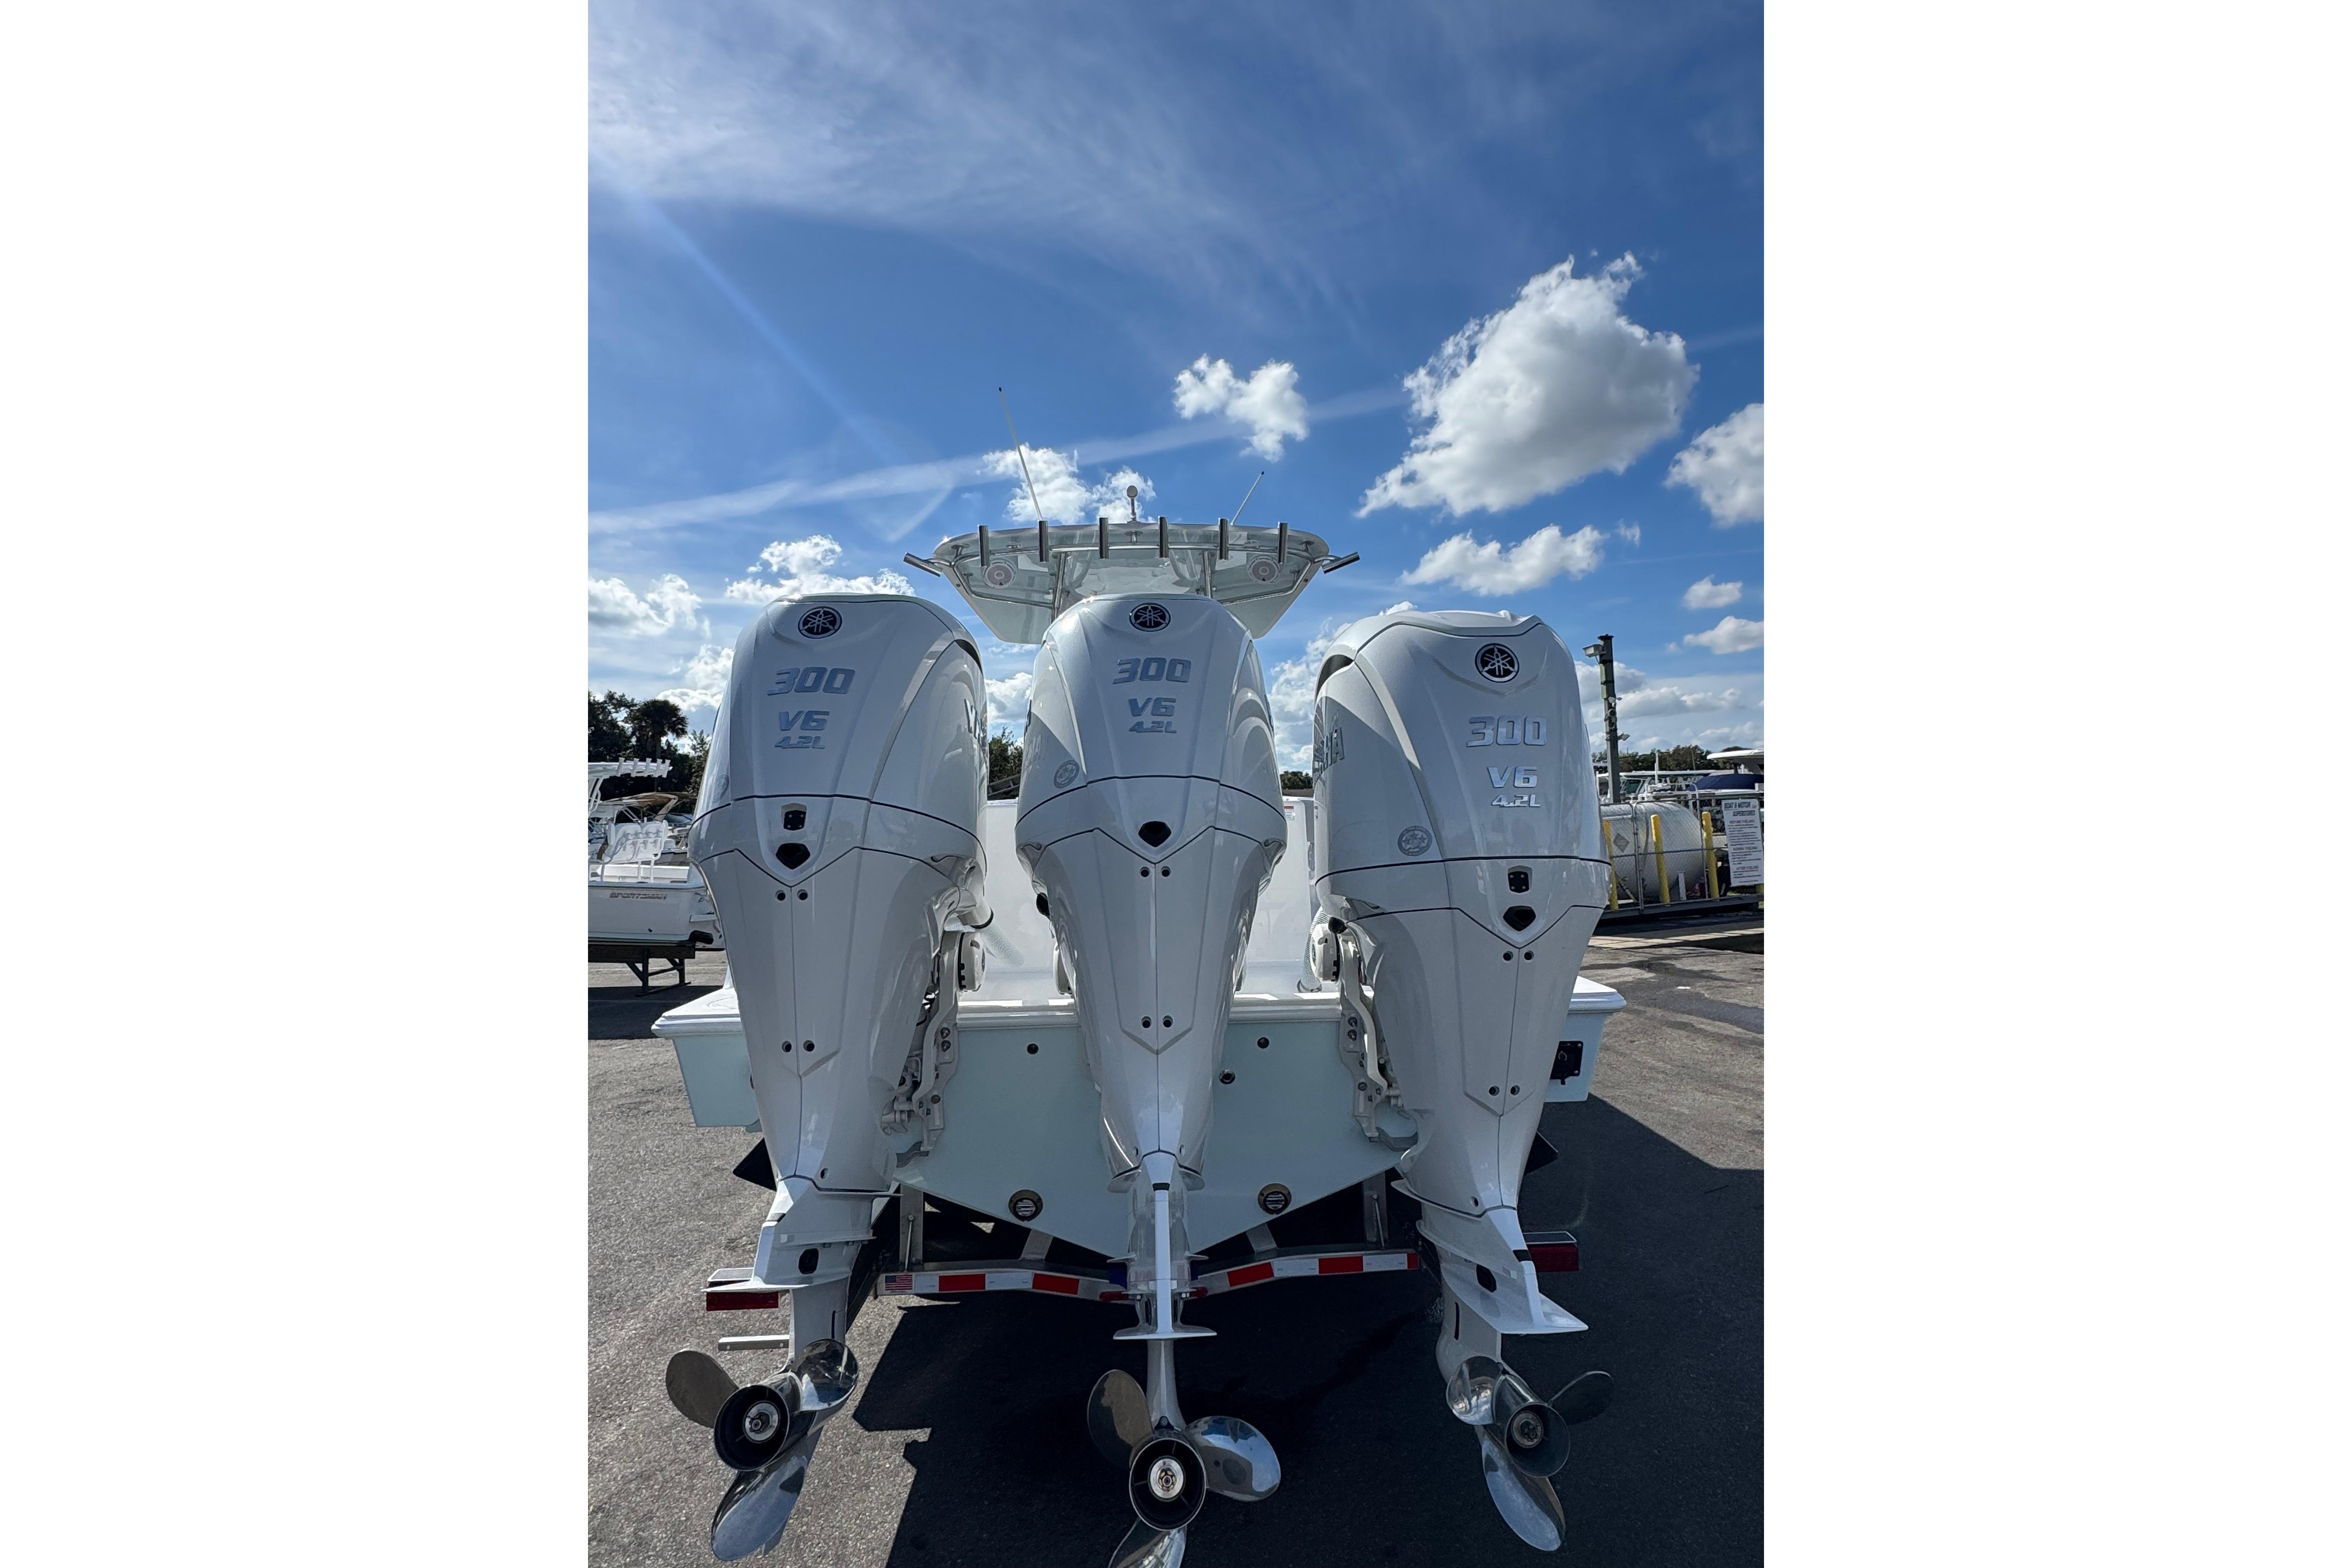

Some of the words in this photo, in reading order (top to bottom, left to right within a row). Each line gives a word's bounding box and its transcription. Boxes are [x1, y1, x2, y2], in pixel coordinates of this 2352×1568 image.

[1112, 657, 1191, 684] 300
[767, 667, 855, 696] 300
[1128, 697, 1176, 717] V6
[779, 710, 830, 731] V6
[1129, 721, 1177, 733] 4.2L
[1466, 715, 1547, 747] 300
[774, 736, 825, 749] 4.2L
[1487, 766, 1537, 788] V6
[1491, 794, 1540, 807] 4.2L
